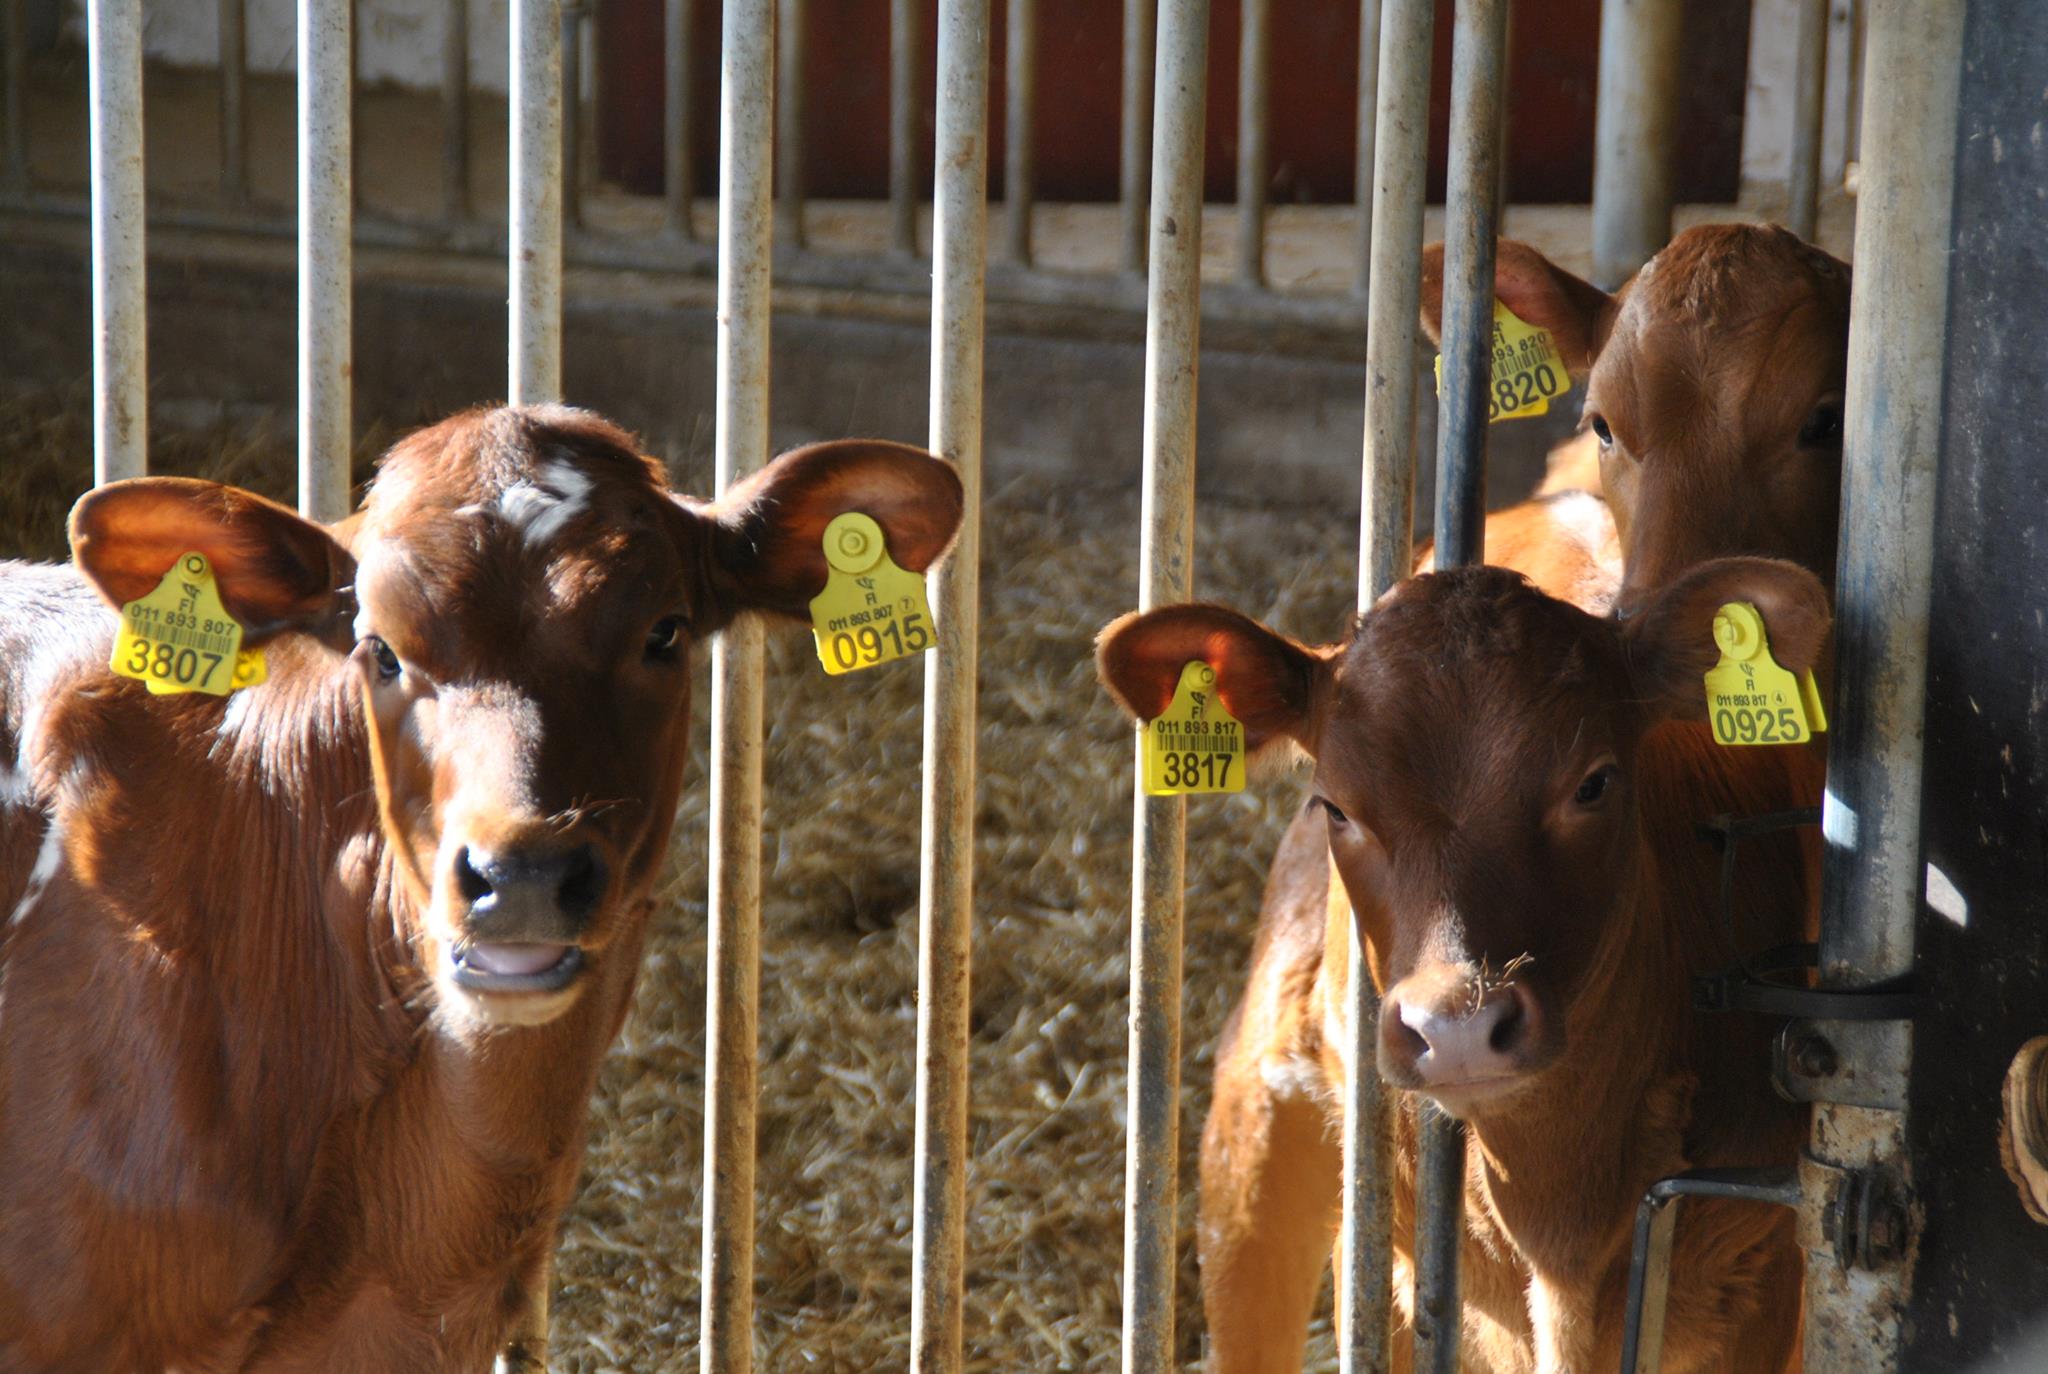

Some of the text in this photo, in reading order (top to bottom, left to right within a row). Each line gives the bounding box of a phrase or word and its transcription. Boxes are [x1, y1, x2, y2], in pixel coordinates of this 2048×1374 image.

[1491, 331, 1546, 363] 93 820
[179, 598, 195, 612] FI
[865, 592, 878, 606] FI
[131, 604, 235, 635] 011 893 807
[828, 617, 848, 632] 011
[832, 613, 928, 670] 0915
[127, 638, 222, 687] 3807
[1716, 694, 1731, 706] 011
[1752, 695, 1767, 706] 817
[1157, 720, 1237, 734] 011 893 817
[1716, 708, 1801, 743] 0925
[1163, 752, 1233, 788] 3817
